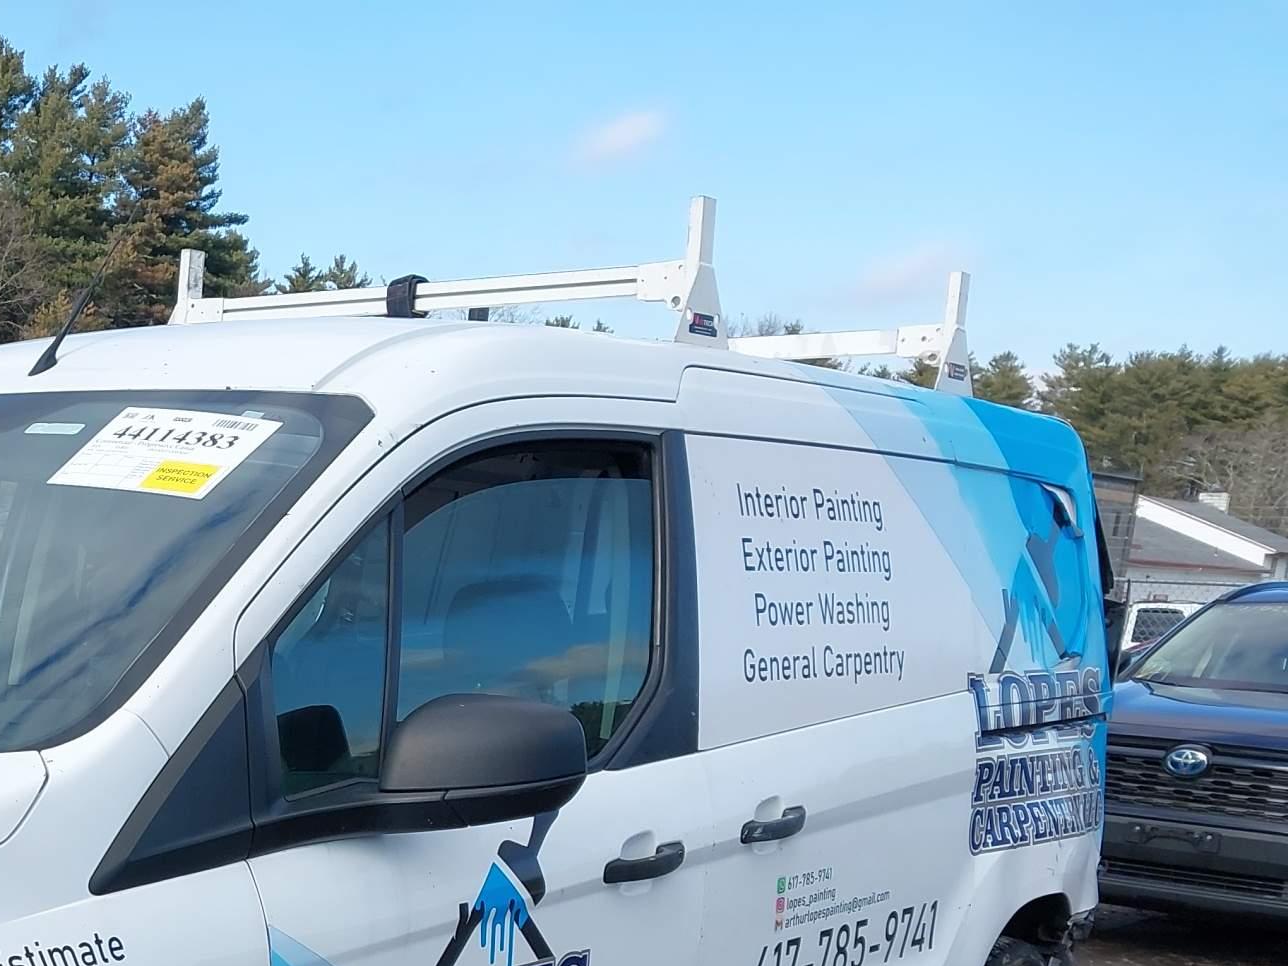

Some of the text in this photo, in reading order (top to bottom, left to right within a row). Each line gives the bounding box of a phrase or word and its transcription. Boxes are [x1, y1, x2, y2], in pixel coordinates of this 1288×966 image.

[113, 425, 240, 450] 44114383
[155, 467, 212, 479] INSPECTION
[155, 474, 198, 486] SERVICE
[737, 483, 883, 531] Interior Painting
[741, 537, 892, 581] Exterior Painting
[754, 592, 890, 632] Power Washing
[743, 645, 905, 684] General Carpentry
[969, 669, 1101, 746] LOPES
[974, 748, 1100, 803] PAINTING &
[969, 794, 1082, 851] CARPENTRY
[787, 868, 833, 890] 617-785-9741
[784, 890, 891, 929] arthurlopespainting@gmail.com
[786, 889, 837, 912] lopes_painting
